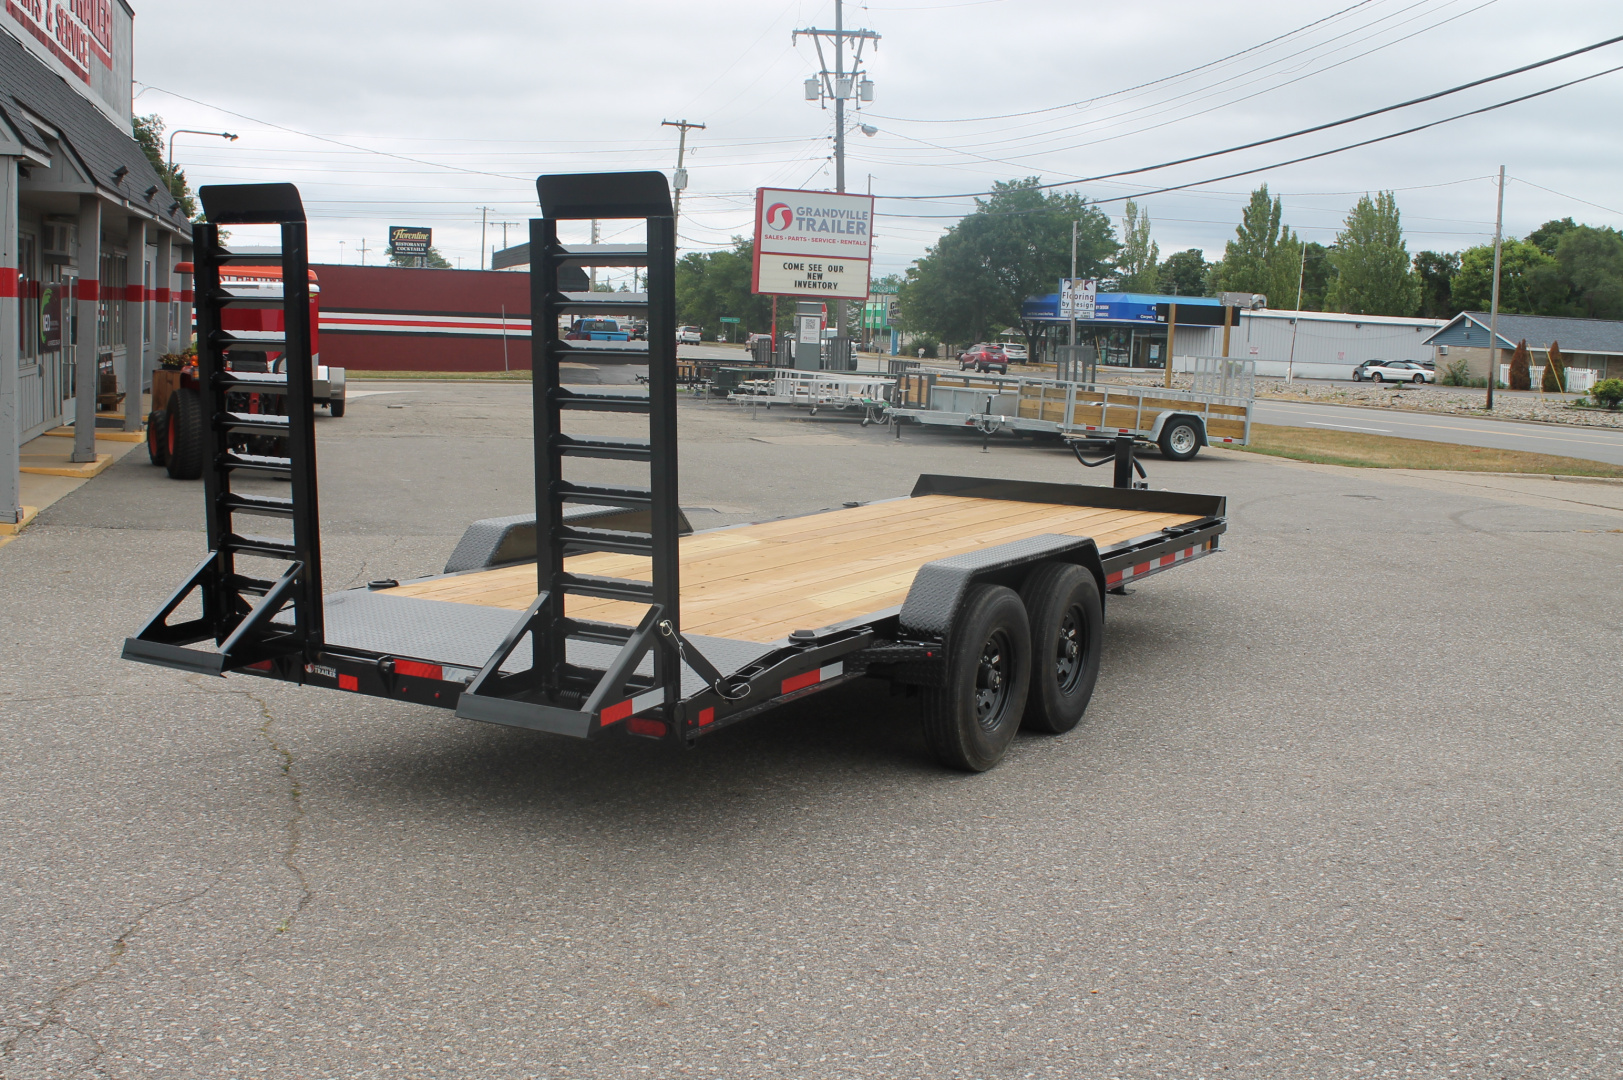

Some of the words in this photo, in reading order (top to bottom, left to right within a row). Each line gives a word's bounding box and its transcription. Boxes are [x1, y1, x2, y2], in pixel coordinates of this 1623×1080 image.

[56, 4, 89, 69] SERVICE
[796, 206, 868, 220] GRANDVILLE
[796, 217, 867, 235] TRAILER
[391, 228, 429, 241] Florentine
[783, 262, 804, 271] COME
[808, 263, 822, 272] SEE
[828, 265, 844, 273] OUR
[807, 272, 823, 280] NEW
[794, 280, 838, 290] INVENTORY
[1072, 301, 1094, 309] esign
[314, 667, 337, 678] TRAILER
